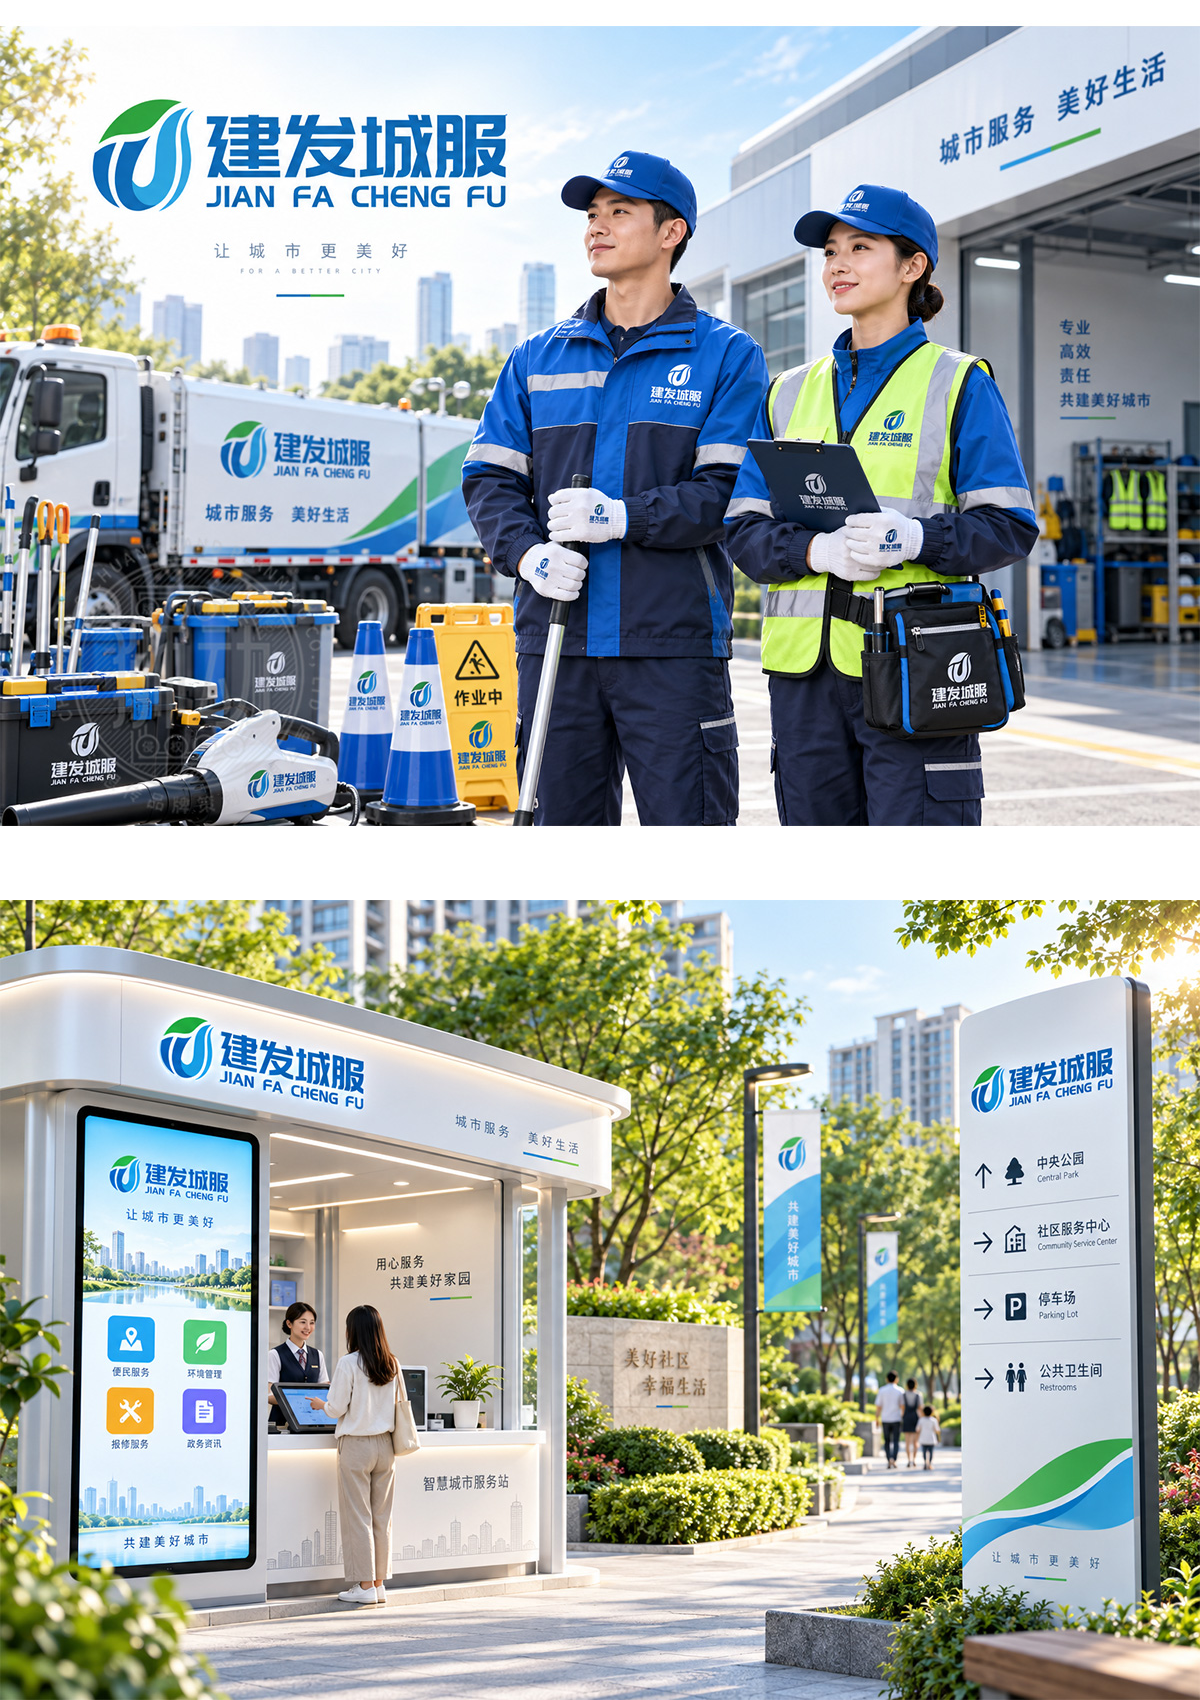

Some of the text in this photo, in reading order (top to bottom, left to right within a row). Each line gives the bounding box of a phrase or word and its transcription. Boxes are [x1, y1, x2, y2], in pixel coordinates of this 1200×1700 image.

[940, 52, 1166, 165] 城市服务 美好生活
[1060, 319, 1090, 335] 专业
[1060, 343, 1091, 359] 高效
[1060, 368, 1091, 383] 责任
[651, 386, 702, 403] 建发城服
[1060, 393, 1151, 407] 共建美好城市
[868, 432, 913, 442] 建发城服
[274, 432, 370, 467] 建发城服
[205, 504, 349, 523] 城市服务 美好生活
[254, 675, 296, 687] 建发城服
[454, 689, 502, 706] 作业中
[931, 683, 987, 702] 建发城服
[349, 696, 385, 706] 建发城服
[400, 709, 441, 721] 建发城服
[457, 750, 506, 764] 建发城服
[51, 757, 116, 778] 建发城服
[273, 770, 316, 787] 建发城服
[221, 1031, 364, 1094] 建发城服
[1009, 1048, 1113, 1094] 建发城服
[220, 1071, 363, 1109] JIAN FA CHENG FU
[455, 1114, 579, 1154] 城市服务 美好生活
[1038, 1152, 1084, 1170] 中央公园
[145, 1163, 228, 1193] 建发城服
[1038, 1171, 1079, 1182] Central Park
[126, 1208, 213, 1228] 让城市更美好
[1038, 1219, 1110, 1238] 社区服务中心
[788, 1201, 799, 1281] 共建美好城市
[1038, 1237, 1117, 1250] Community Service Center
[376, 1255, 424, 1271] 用心服务
[390, 1272, 470, 1290] 共建美好家园
[1038, 1291, 1075, 1306] 停车场
[1039, 1310, 1078, 1321] Parking Lot
[625, 1349, 690, 1370] 美好社区
[113, 1367, 149, 1377] 便民服务
[187, 1369, 222, 1379] 环境管理
[1040, 1363, 1102, 1378] 公共卫生间
[642, 1377, 707, 1396] 幸福生活
[1040, 1383, 1077, 1391] Restrooms
[112, 1440, 148, 1449] 报修服务
[187, 1439, 221, 1448] 政务资讯
[424, 1475, 509, 1491] 智慧城市服务站
[124, 1534, 208, 1549] 共建美好城市
[992, 1552, 1100, 1569] 让城市更美好
